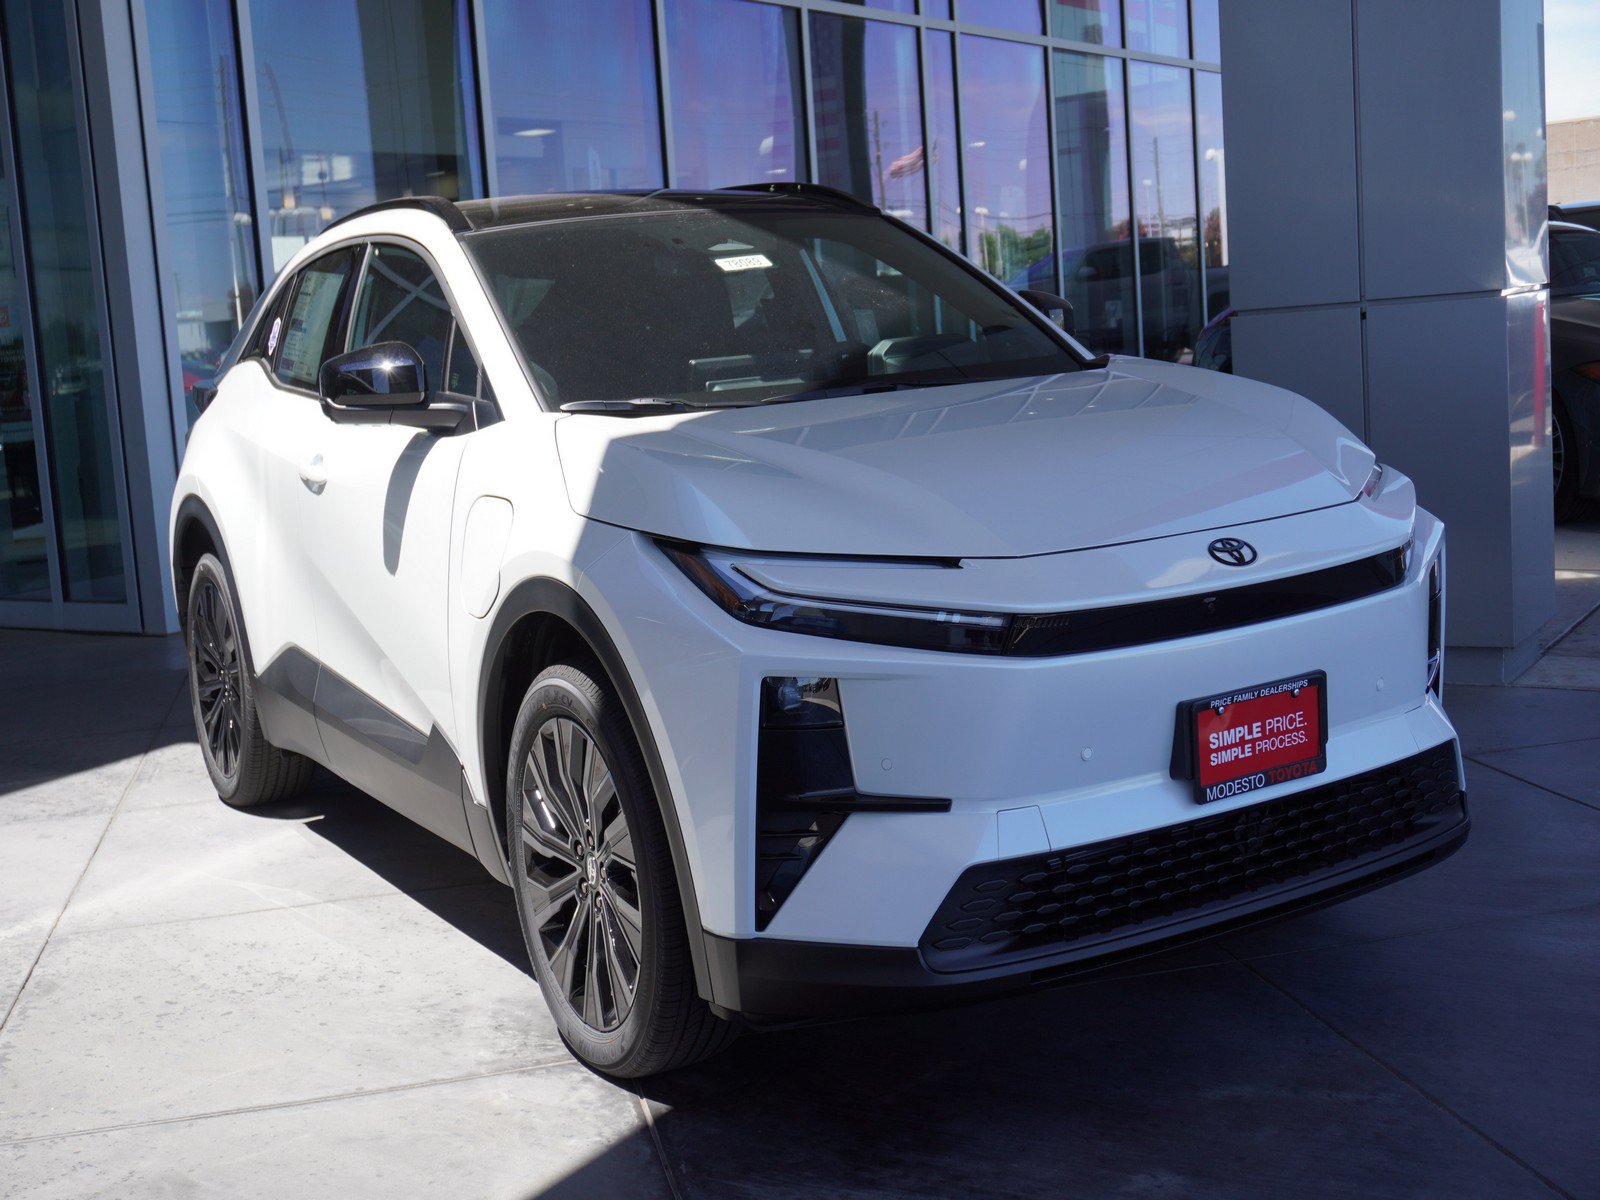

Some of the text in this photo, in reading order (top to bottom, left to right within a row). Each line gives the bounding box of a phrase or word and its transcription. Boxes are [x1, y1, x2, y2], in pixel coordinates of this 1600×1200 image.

[1211, 679, 1308, 708] PRICE FAMILY DEALERSHIPS
[1209, 711, 1307, 749] SIMPLE PRICE.
[1210, 731, 1308, 766] SIMPLE PROCESS.
[1206, 761, 1318, 802] MODESTO TOYOTA
